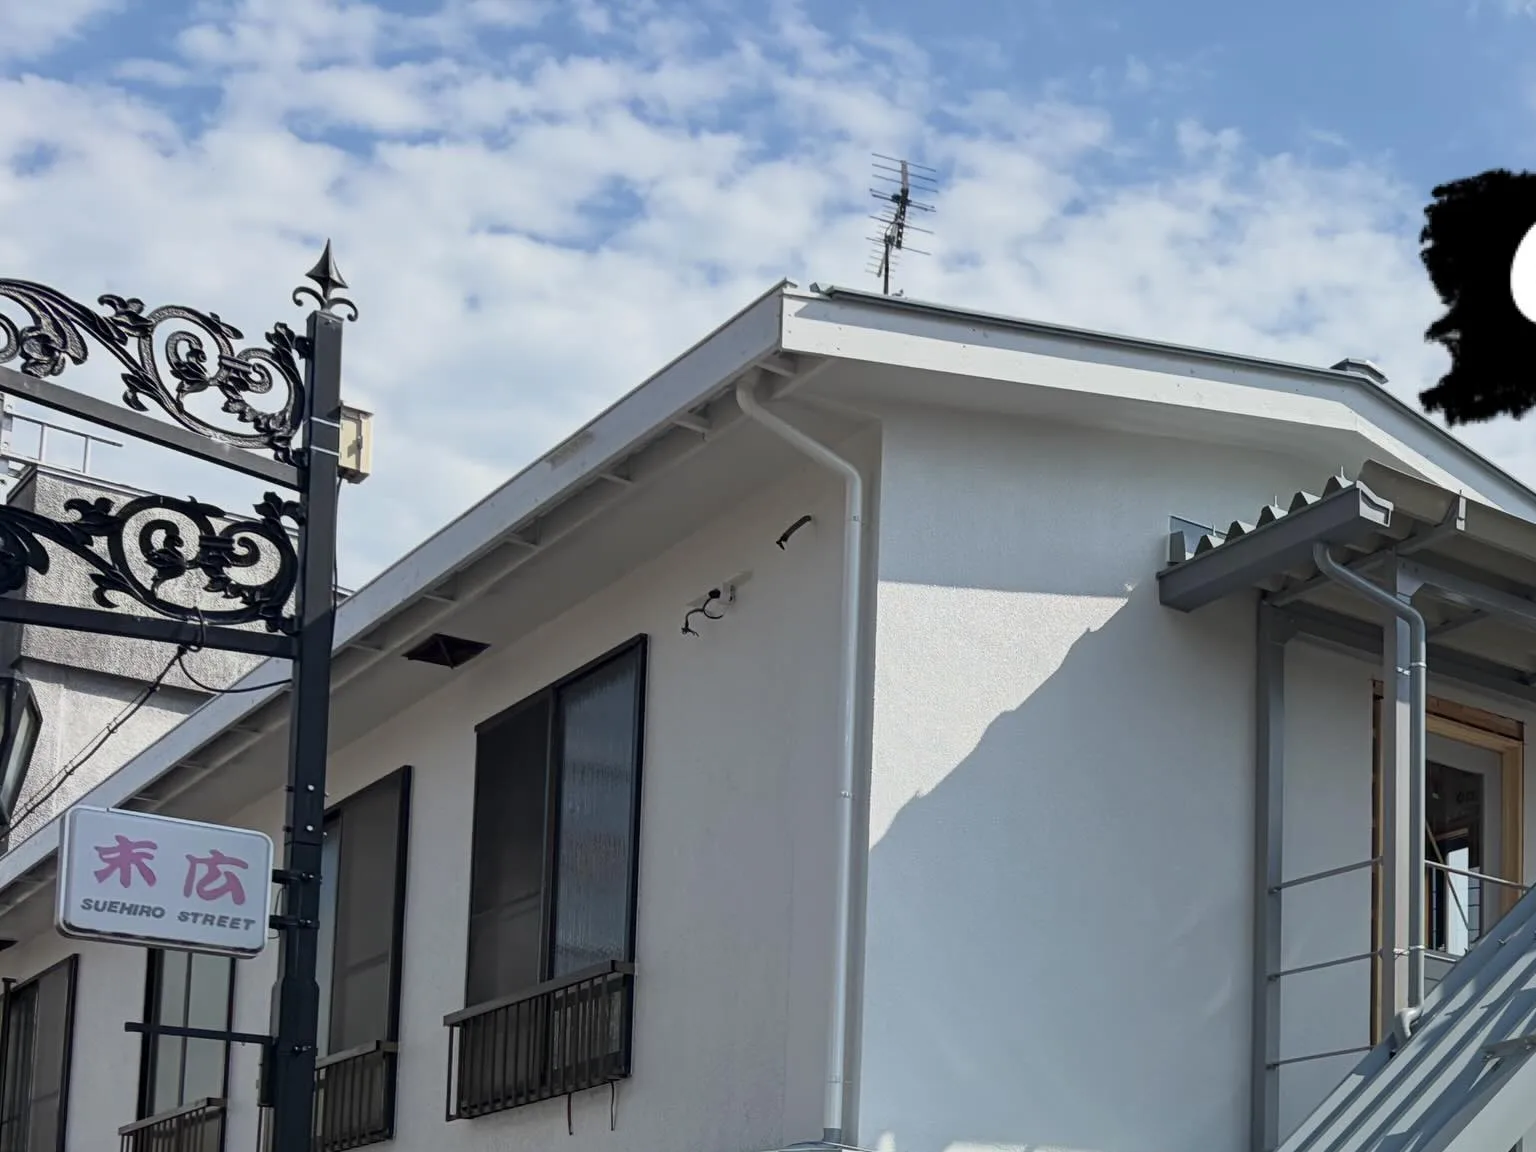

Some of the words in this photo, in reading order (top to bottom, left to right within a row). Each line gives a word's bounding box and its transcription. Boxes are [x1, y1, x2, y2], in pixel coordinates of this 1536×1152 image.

[94, 834, 249, 905] 末広
[80, 898, 166, 919] SUEHIRO
[177, 911, 256, 931] STREET
